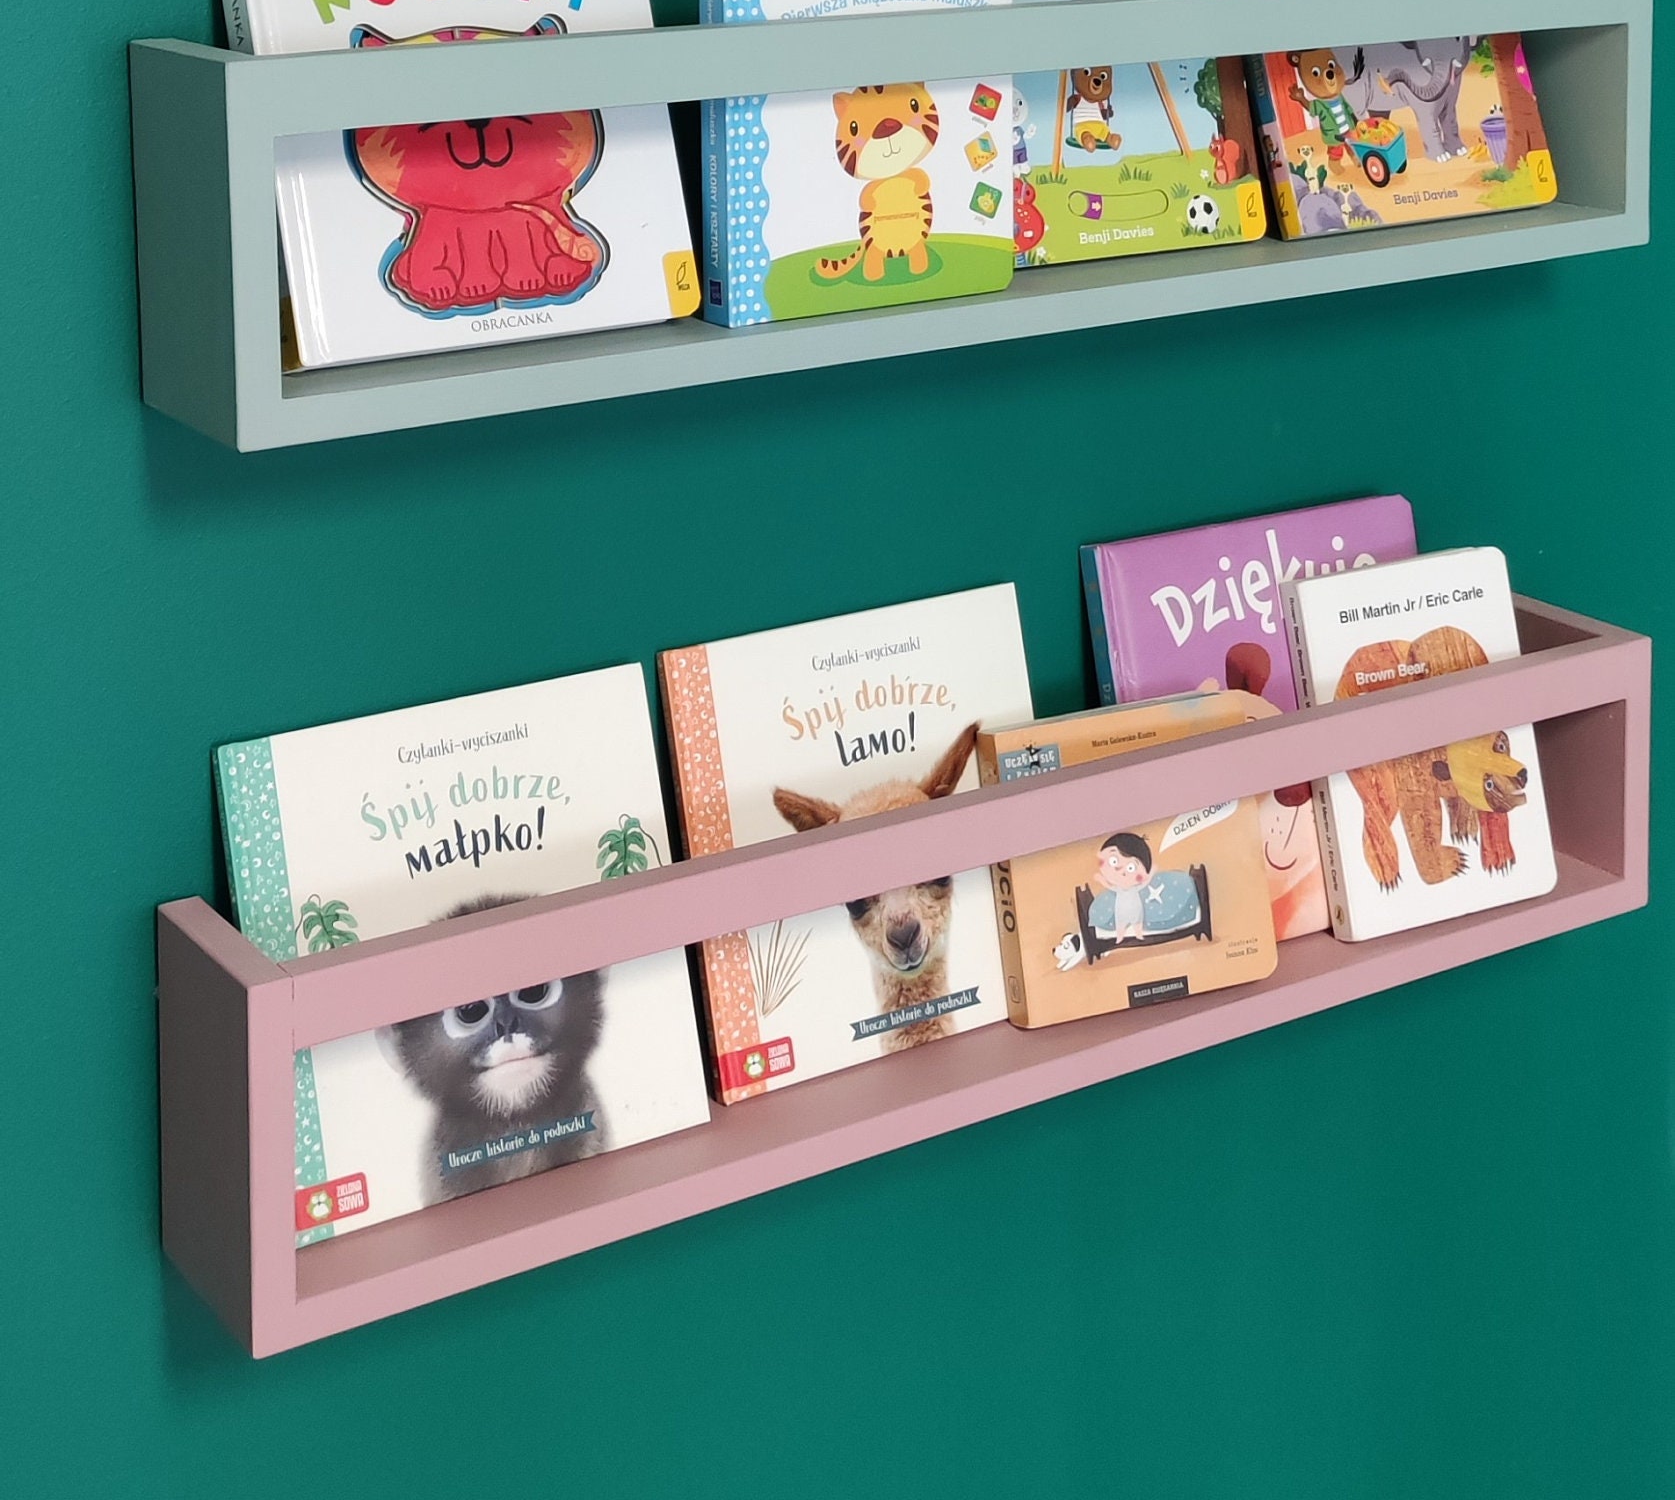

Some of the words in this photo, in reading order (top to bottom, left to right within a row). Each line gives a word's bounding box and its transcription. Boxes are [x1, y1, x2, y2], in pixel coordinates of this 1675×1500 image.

[709, 154, 718, 202] KOLORY
[1393, 191, 1421, 205] Benji
[1422, 188, 1459, 202] Davies
[1078, 229, 1111, 244] Benji
[1112, 225, 1155, 240] Davies
[471, 311, 553, 332] OBRACANKA
[1150, 528, 1377, 648] Dzięk
[1339, 608, 1359, 624] Bill
[1362, 602, 1401, 620] Martin
[1403, 598, 1416, 612] Jr
[1425, 592, 1450, 608] Eric
[1452, 586, 1484, 603] Carle
[811, 636, 921, 672] Czytanki-wyciszanki
[1355, 667, 1395, 686] Brown
[1397, 662, 1430, 677] Bear,
[782, 685, 847, 741] Śpij
[397, 722, 529, 764] Czytanki-wyciszanki
[834, 710, 916, 767] lamo!
[1004, 753, 1030, 769] UCZĘ
[1039, 750, 1055, 764] SIĘ
[360, 779, 439, 842] Śpij
[449, 765, 571, 808] dobrze,
[405, 805, 545, 879] małpko!
[859, 1019, 888, 1035] Urocze
[924, 1002, 935, 1015] do
[448, 1149, 482, 1168] Urocze
[485, 1135, 525, 1157] historie
[528, 1129, 541, 1145] do
[543, 1115, 586, 1144] poduszki
